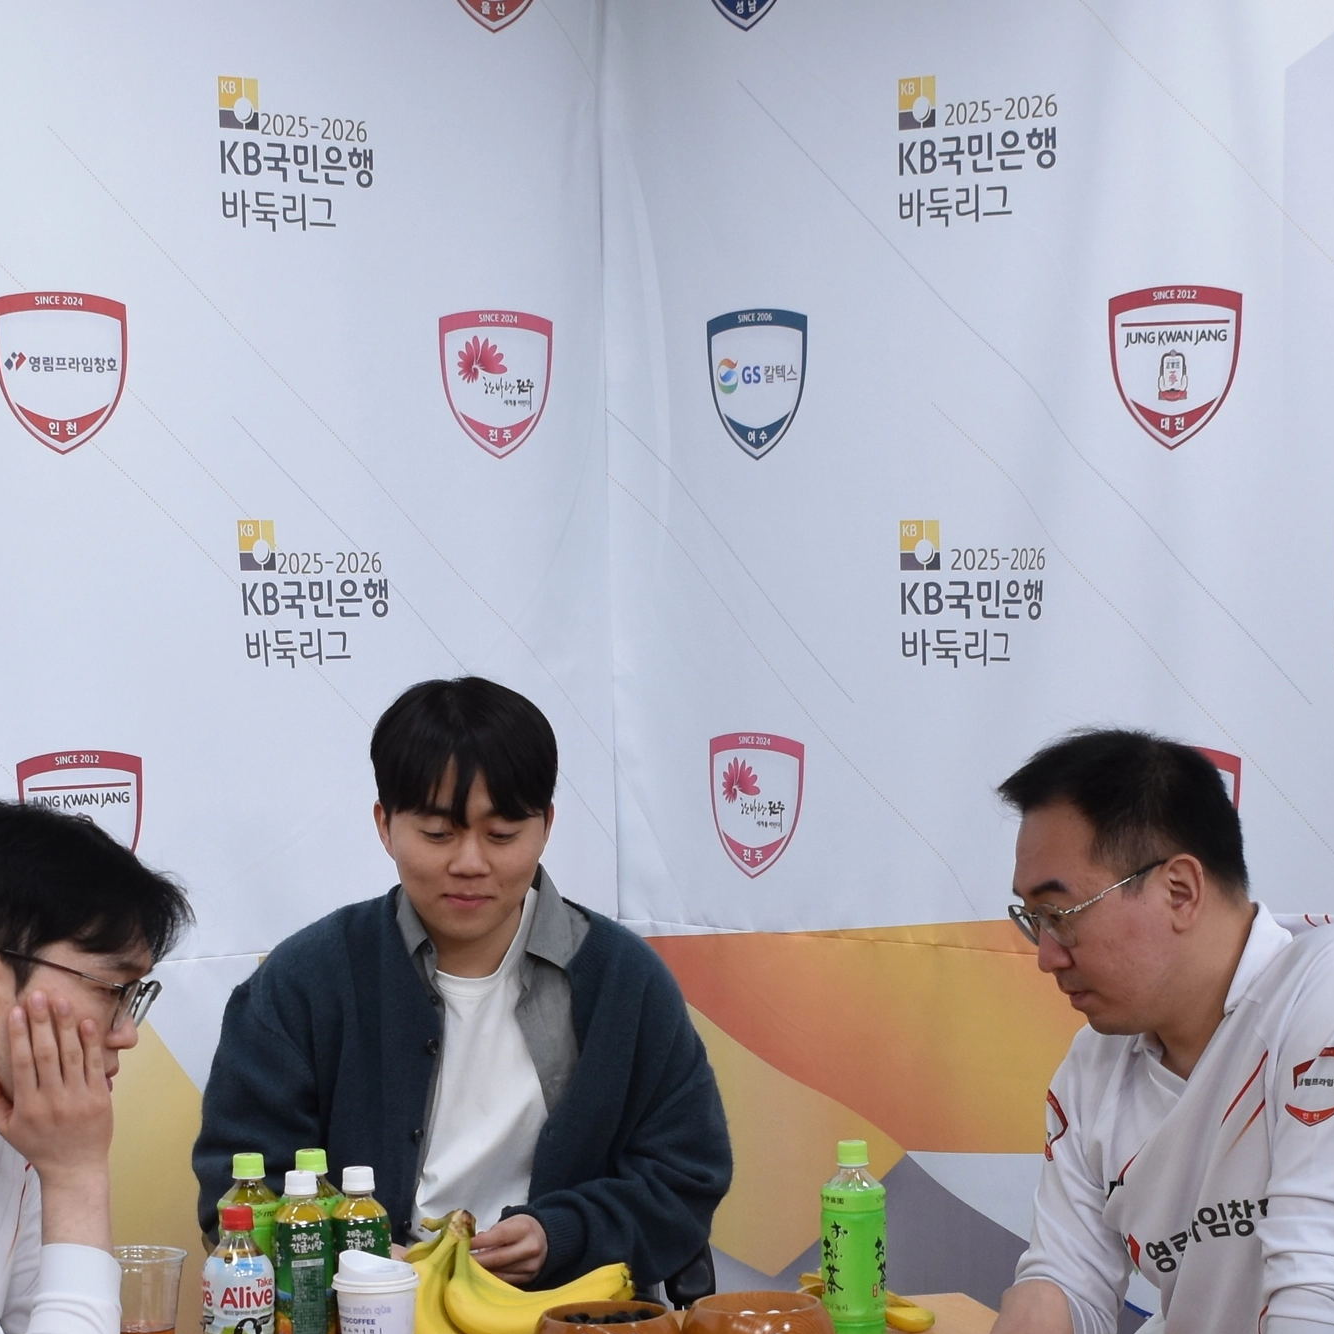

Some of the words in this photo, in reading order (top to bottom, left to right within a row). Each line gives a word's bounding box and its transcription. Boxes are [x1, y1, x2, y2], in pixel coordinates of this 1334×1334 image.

[220, 80, 237, 94] KB
[900, 81, 915, 96] KB
[944, 93, 1058, 127] 2025-2026
[260, 112, 368, 146] 2025-2026
[898, 125, 1057, 177] KB국민은행
[219, 140, 374, 189] KB국민은행
[221, 189, 337, 233] 바둑리그
[898, 183, 1013, 228] 바둑리그
[34, 295, 60, 306] SINCE
[62, 295, 83, 307] 2024
[1151, 286, 1175, 301] SINCE
[1176, 289, 1197, 300] 2012
[478, 313, 499, 323] SINCE
[500, 313, 518, 324] 2024
[1124, 331, 1156, 349] JUNG
[1157, 329, 1193, 346] KWAN
[1193, 328, 1228, 346] JANG
[28, 355, 118, 374] 영림프라임창호
[741, 365, 762, 385] GS
[763, 364, 798, 384] 칼텍스
[48, 420, 79, 437] 인천
[1159, 416, 1186, 432] 대전
[488, 429, 513, 442] 전주
[747, 430, 768, 443] 여수
[237, 523, 255, 541] KB
[899, 523, 918, 537] KB
[277, 551, 382, 575] 2025-2026
[950, 547, 1046, 571] 2025-2026
[241, 577, 389, 620] KB국민은행
[900, 578, 1044, 621] KB국민은행
[245, 628, 352, 669] 바둑리그
[901, 628, 1011, 669] 바둑리그
[53, 751, 77, 766] SINCE
[79, 754, 100, 764] 2012
[62, 792, 99, 810] KWAN
[100, 791, 130, 809] JANG
[742, 847, 764, 862] 전주
